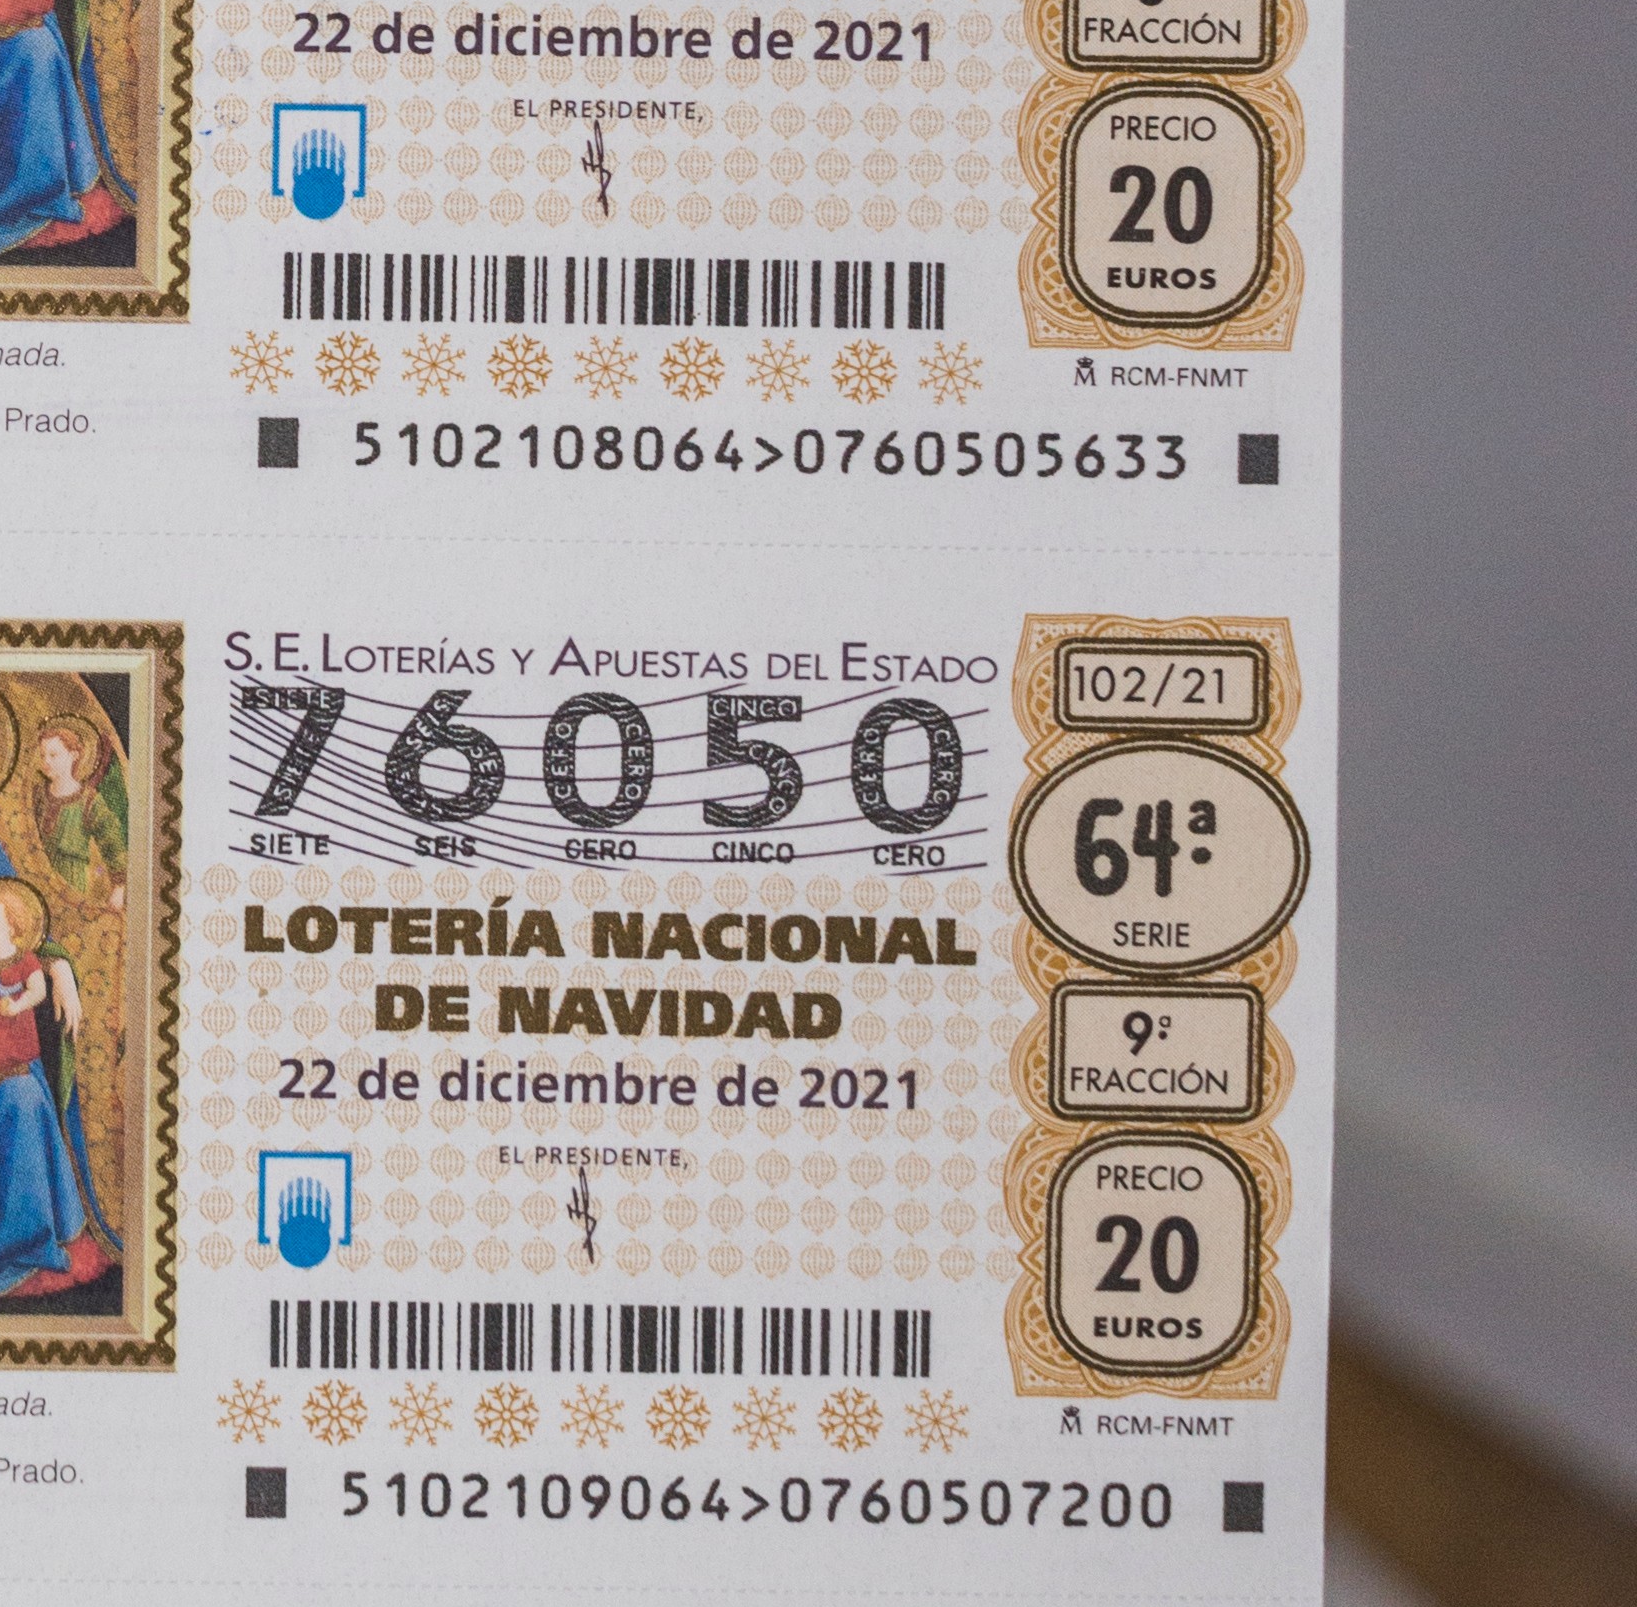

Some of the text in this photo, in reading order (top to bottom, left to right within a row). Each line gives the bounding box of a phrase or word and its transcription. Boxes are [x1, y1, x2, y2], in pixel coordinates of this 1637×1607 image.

[292, 10, 933, 62] 22 de diciembre de 2021
[1083, 12, 1242, 46] FRACCIÓN
[1110, 366, 1248, 389] RCM-FNMT
[355, 421, 1187, 480] 5102108064>0760505633
[512, 649, 534, 675] Y
[548, 636, 749, 680] APUESTAS
[766, 654, 829, 682] DEL
[841, 642, 999, 685] ESTADO
[1074, 662, 1224, 708] 102/21
[242, 686, 966, 834] 76050
[238, 894, 977, 967] LOTERÍA NACIONAL
[1112, 921, 1191, 948] SERIE
[373, 983, 843, 1041] DE NAVIDAD
[1071, 1062, 1229, 1096] FRACCIÓN
[343, 1471, 1172, 1529] 5102109064>0760507200
